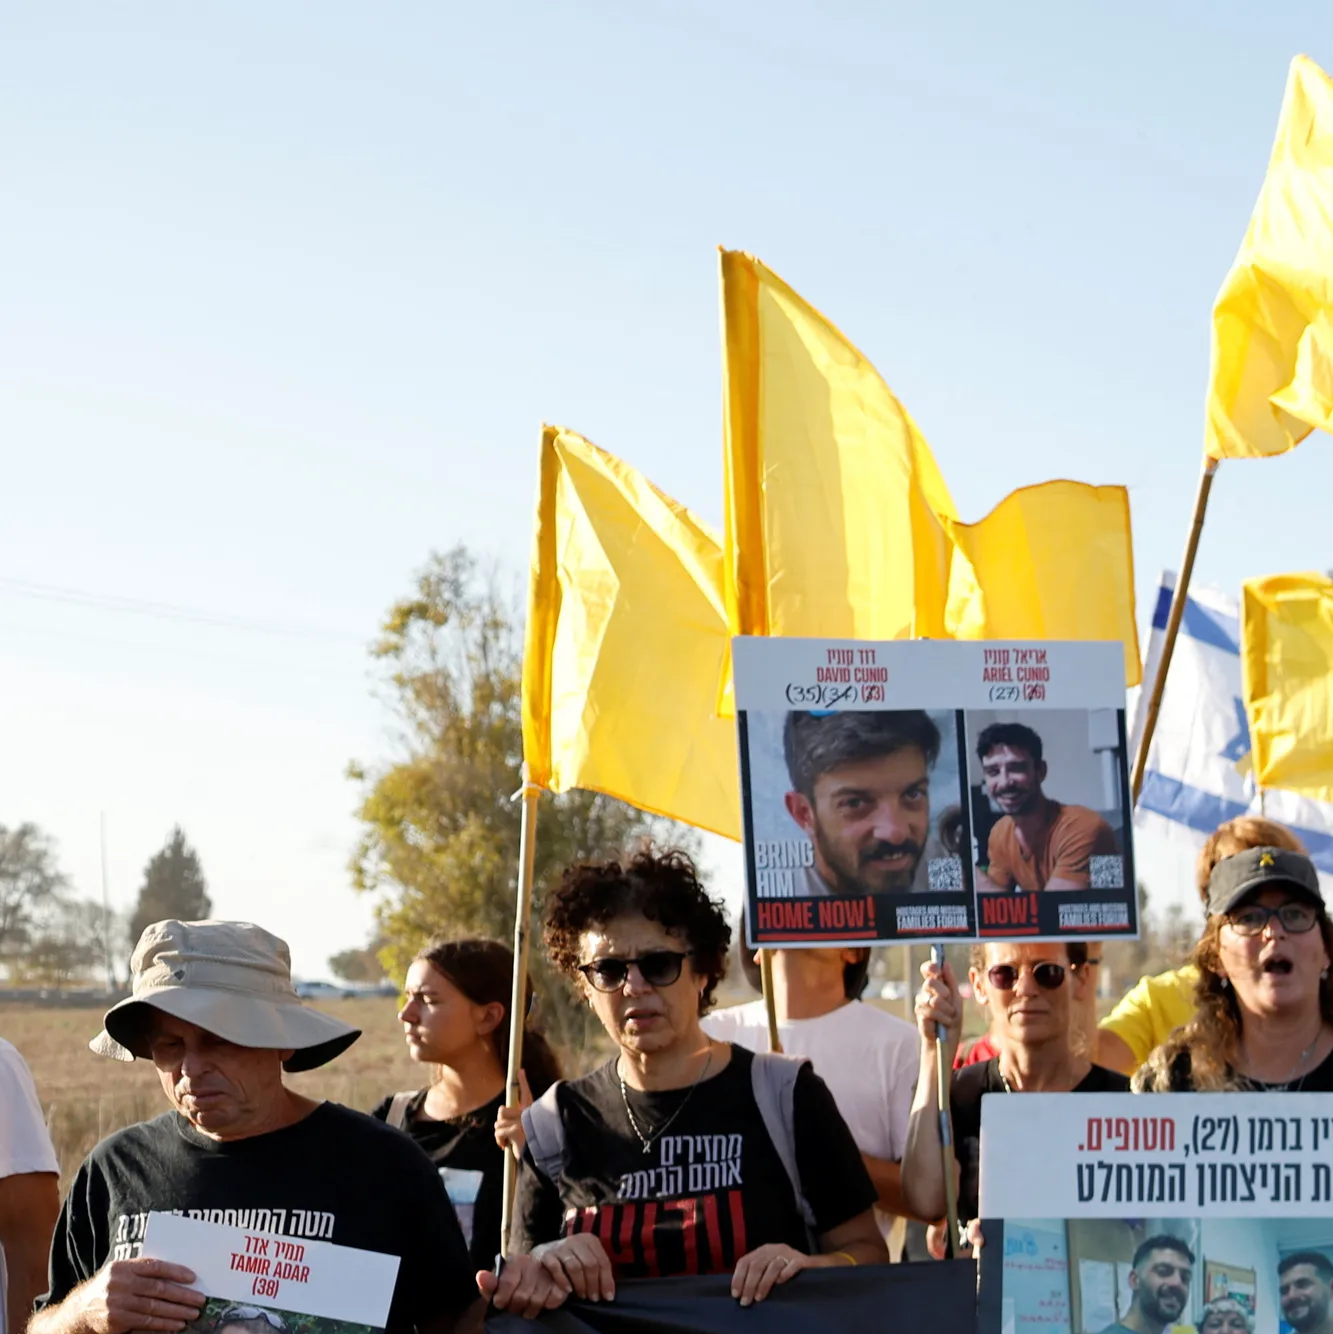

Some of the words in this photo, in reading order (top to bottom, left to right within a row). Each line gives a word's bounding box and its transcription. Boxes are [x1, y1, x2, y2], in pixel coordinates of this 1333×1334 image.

[1012, 648, 1047, 664] אריאל
[816, 666, 850, 683] DAVID
[854, 667, 888, 683] CUNIO
[983, 666, 1013, 683] ARIEL
[1016, 666, 1050, 683] CUNIO
[989, 685, 1020, 702] (27)
[755, 840, 815, 869] BRING
[756, 870, 795, 898] HIM
[757, 901, 813, 929] HOME
[819, 896, 875, 929] NOW!
[897, 915, 936, 930] FAMILIES
[937, 914, 968, 930] FORUM
[982, 893, 1039, 925] NOW!
[1077, 1117, 1175, 1151] חטופים.
[1248, 1117, 1302, 1155] ברמן
[661, 1134, 742, 1166] מחזירים
[617, 1165, 683, 1199] הביתה
[689, 1158, 742, 1192] אותם
[1076, 1160, 1186, 1202] המוחלט
[1196, 1163, 1302, 1206] הניצחון
[292, 1209, 335, 1239] מטה
[244, 1235, 270, 1256] אדר
[273, 1240, 305, 1262] תמיר
[230, 1252, 270, 1277] TAMIR
[273, 1263, 310, 1283] ADAR
[252, 1276, 279, 1299] (38)
